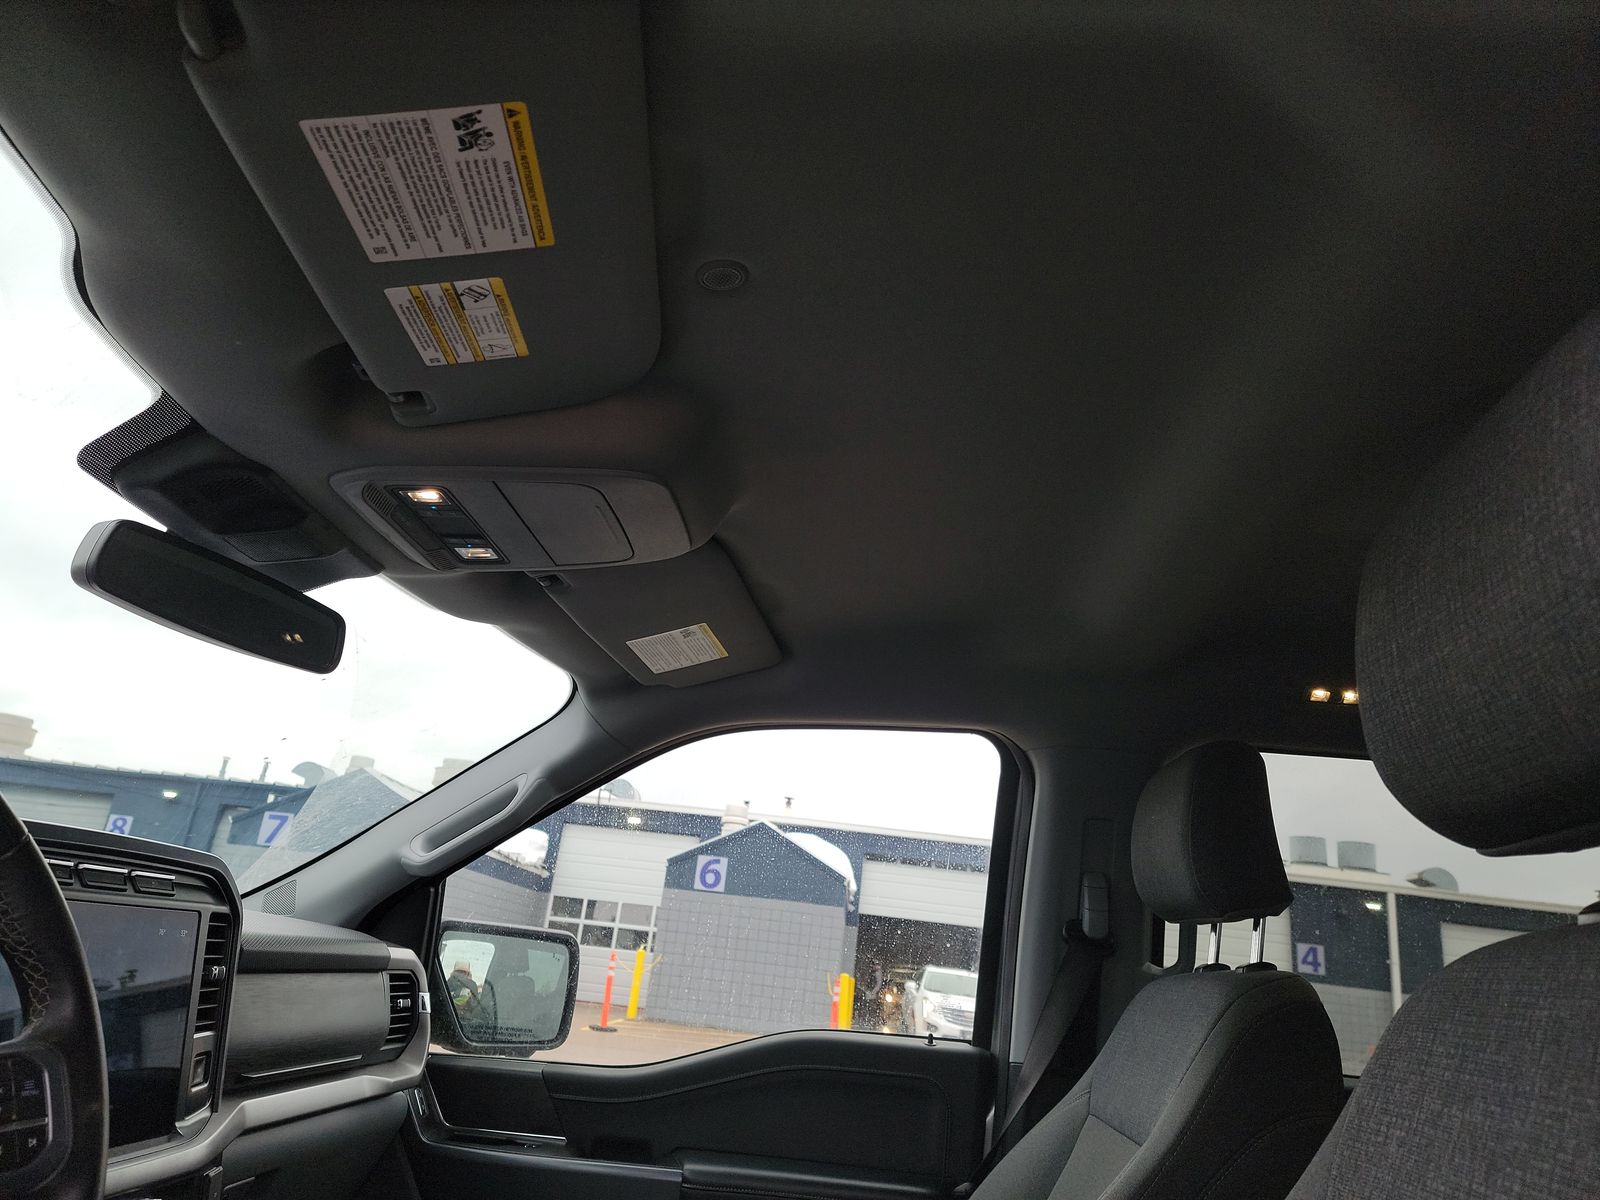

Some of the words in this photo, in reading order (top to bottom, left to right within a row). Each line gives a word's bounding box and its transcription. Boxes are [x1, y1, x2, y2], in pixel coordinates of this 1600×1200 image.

[511, 120, 526, 150] WARNING
[111, 817, 128, 834] 8
[265, 814, 289, 844] 7
[700, 859, 721, 889] 6
[1301, 946, 1321, 972] 4
